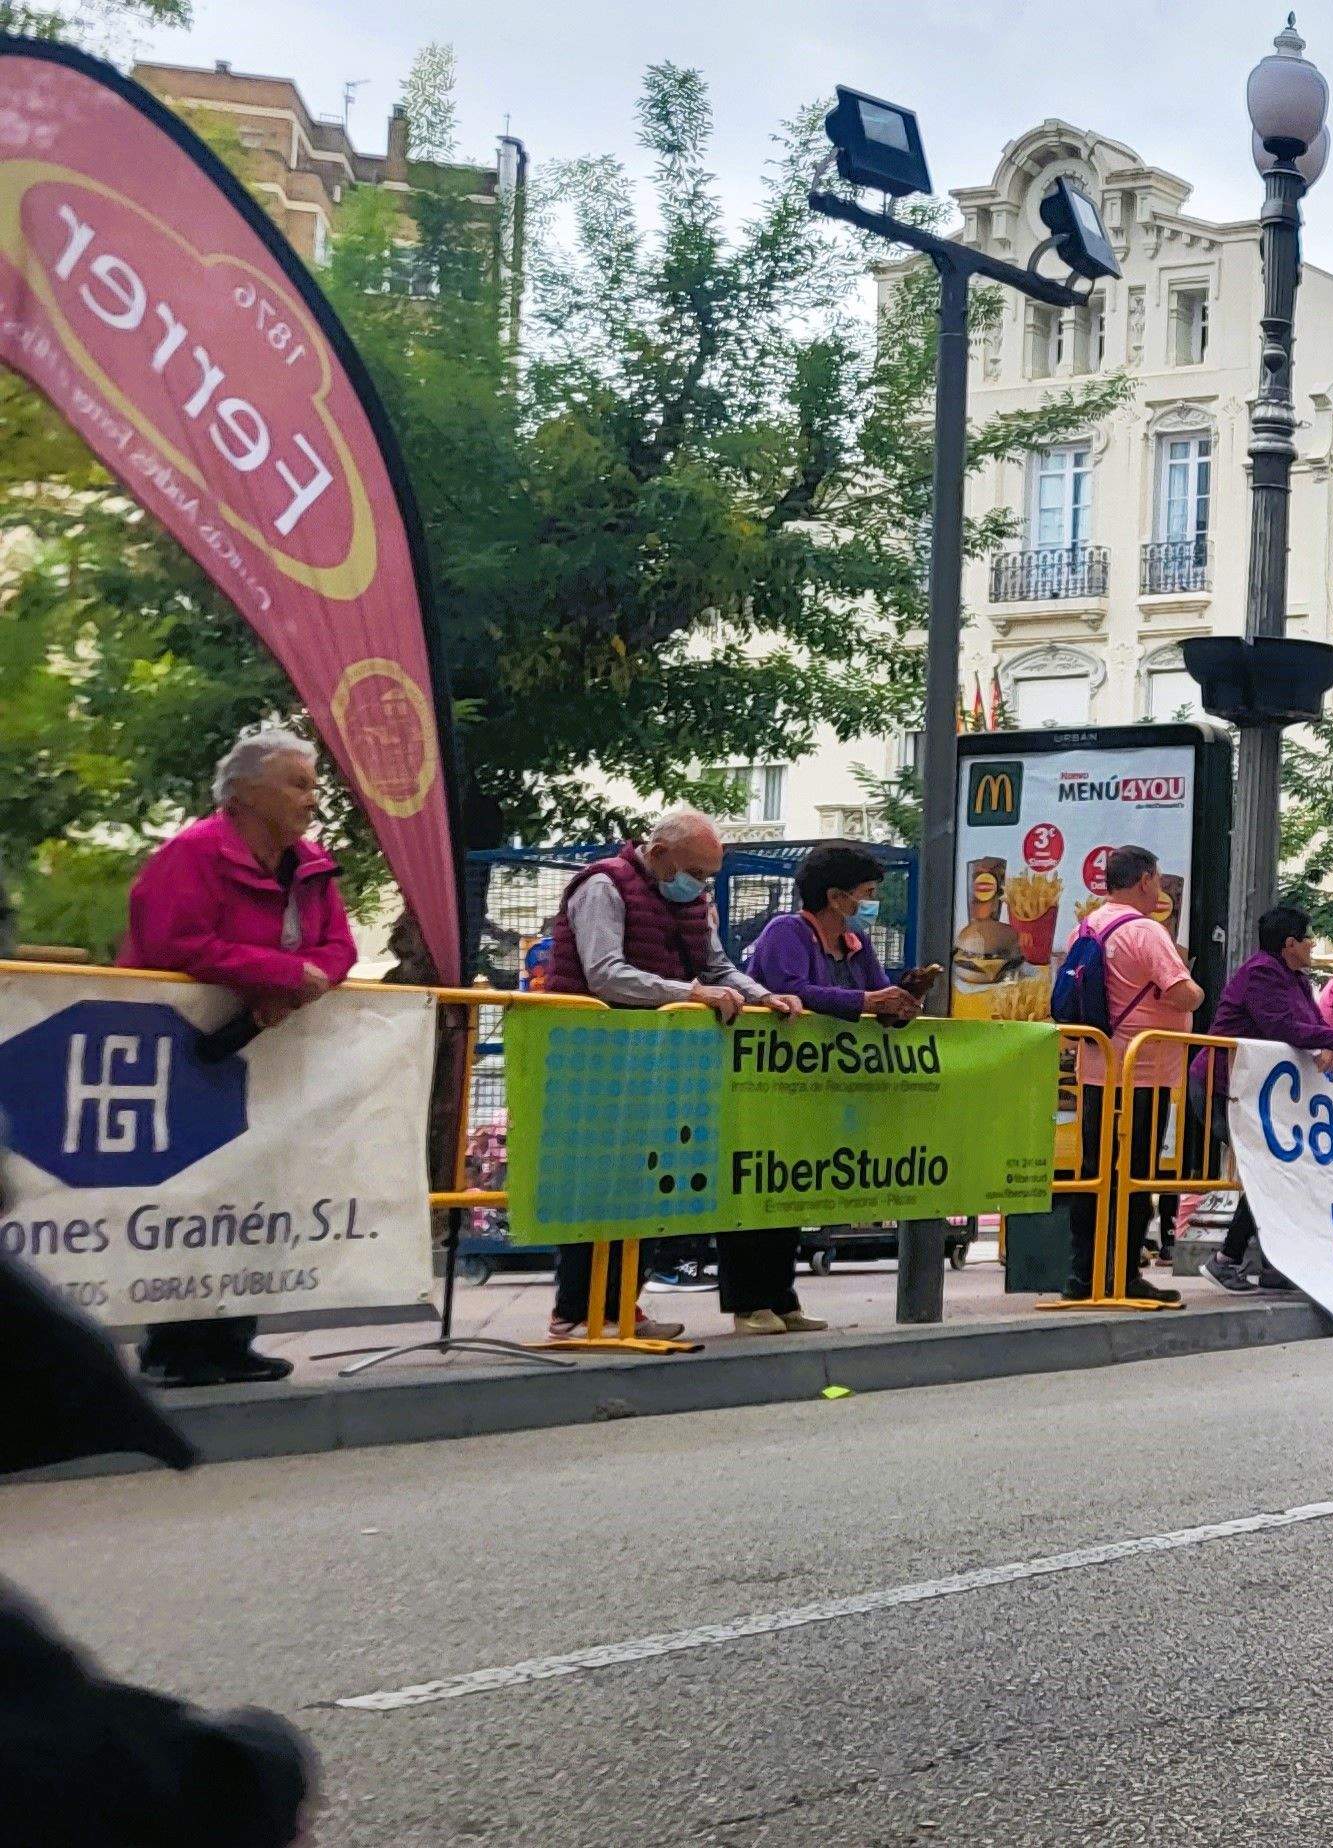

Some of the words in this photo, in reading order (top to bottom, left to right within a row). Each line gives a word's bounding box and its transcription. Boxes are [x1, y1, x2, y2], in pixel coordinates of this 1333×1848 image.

[733, 1029, 940, 1075] FiberSalud
[732, 1146, 949, 1195] FiberStudio
[127, 1202, 300, 1251] Grañén,
[308, 1197, 379, 1242] S.L.
[129, 1275, 213, 1303] OBRAS
[218, 1266, 320, 1299] PÚBLICAS
